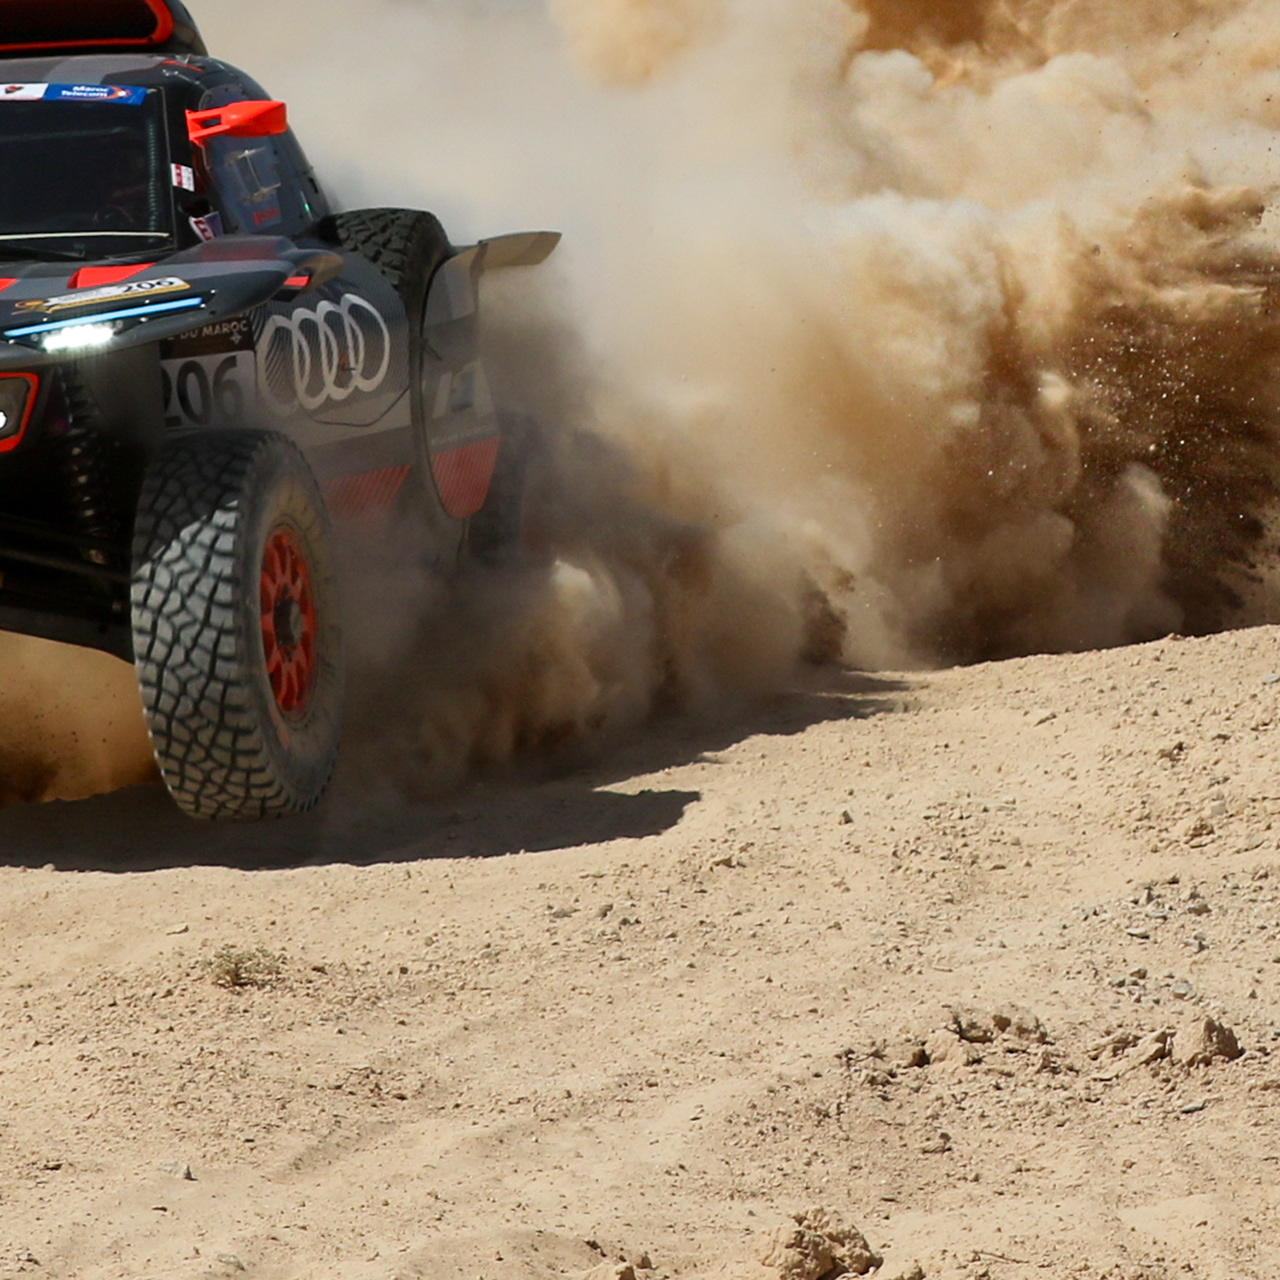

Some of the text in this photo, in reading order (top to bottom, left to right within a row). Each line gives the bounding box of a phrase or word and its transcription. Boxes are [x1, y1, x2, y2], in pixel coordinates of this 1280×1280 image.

[61, 90, 108, 98] Telecom
[72, 85, 109, 93] Maroc
[123, 279, 175, 293] 206
[202, 320, 249, 337] MAROC
